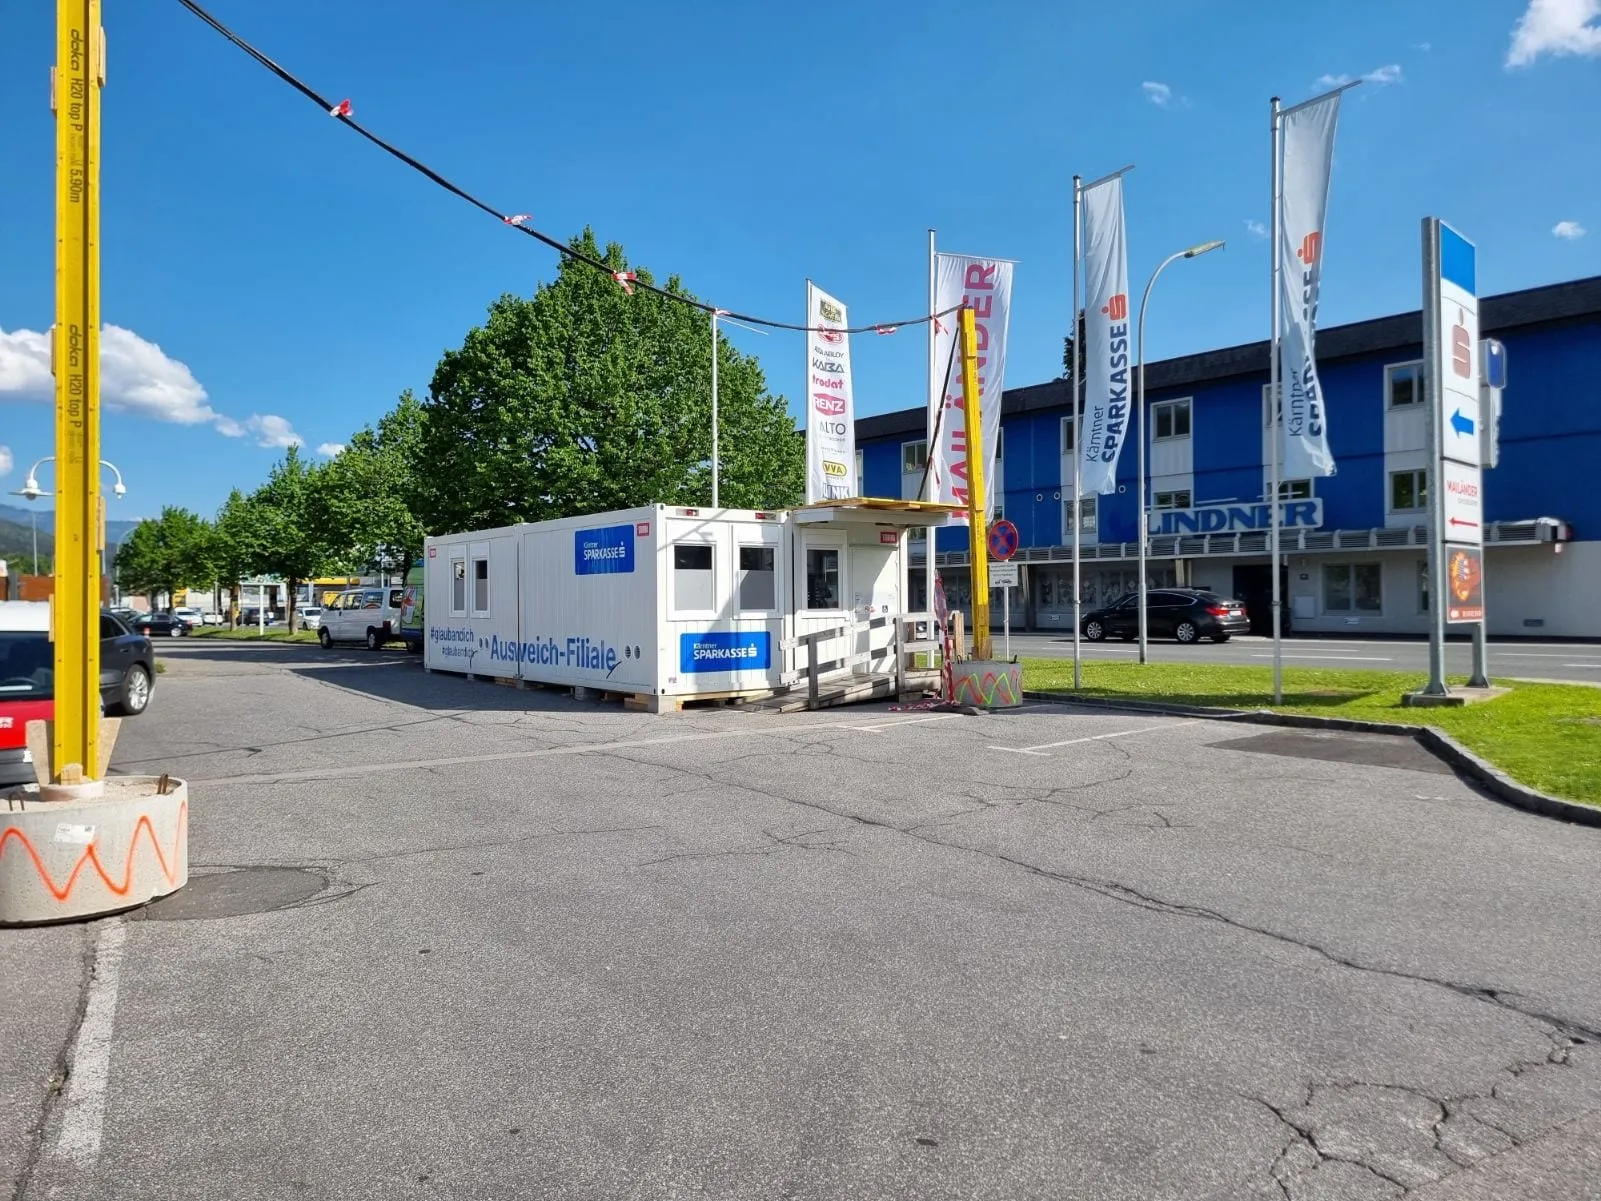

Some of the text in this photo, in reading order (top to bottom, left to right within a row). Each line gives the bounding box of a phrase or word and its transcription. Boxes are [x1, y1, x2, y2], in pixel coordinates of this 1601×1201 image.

[70, 29, 84, 71] doka
[70, 77, 84, 100] H20
[68, 100, 83, 121] top
[70, 123, 84, 132] P
[69, 324, 83, 367] doka
[812, 356, 845, 373] KABA
[69, 374, 83, 396] H20
[812, 373, 844, 389] trodat
[1101, 323, 1128, 463] SPARKASSE
[67, 396, 82, 417] top
[69, 420, 83, 429] P
[1086, 405, 1104, 463] Kärntner
[583, 547, 619, 561] SPARKASSE
[490, 634, 617, 671] Ausweich-Filiale
[693, 647, 748, 660] SPARKASSE
